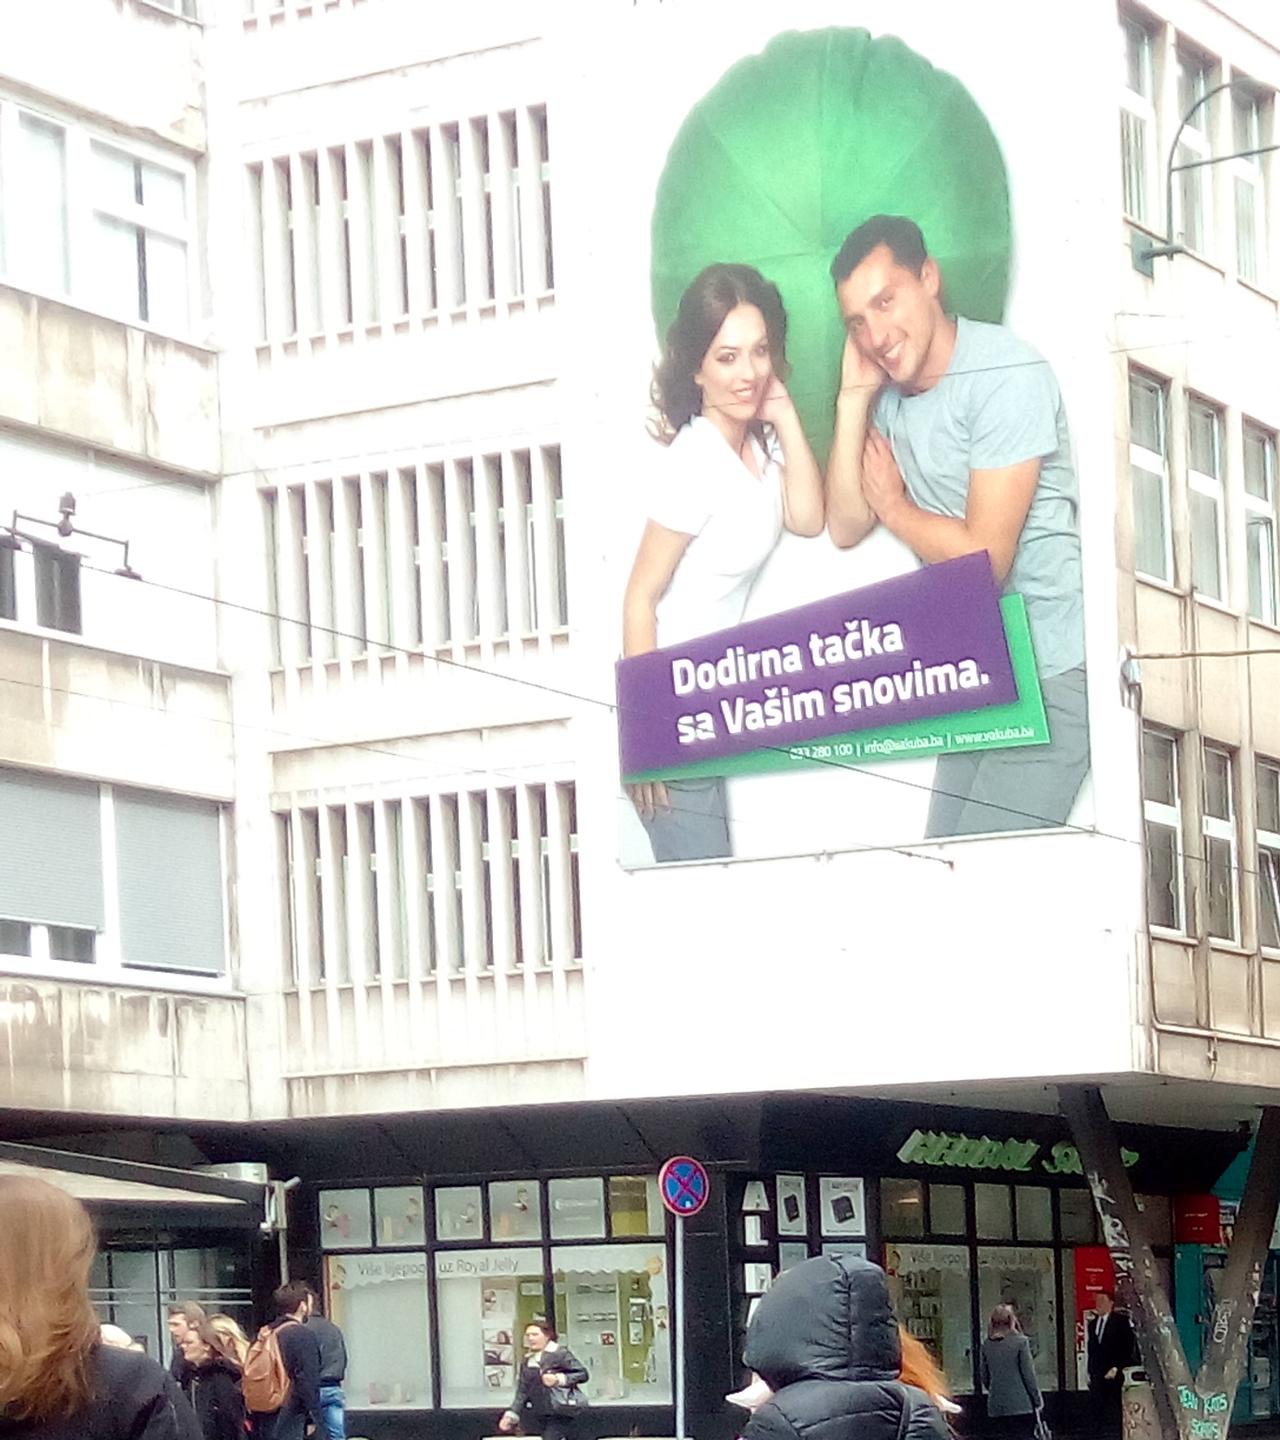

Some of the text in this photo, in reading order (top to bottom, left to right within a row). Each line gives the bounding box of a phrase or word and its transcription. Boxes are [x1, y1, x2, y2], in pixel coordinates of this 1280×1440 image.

[671, 619, 903, 697] Dodirna tačka
[678, 655, 990, 745] sa Vašim snovima.
[833, 743, 853, 756] 100
[456, 1259, 489, 1273] Royal
[491, 1258, 519, 1273] Jelly
